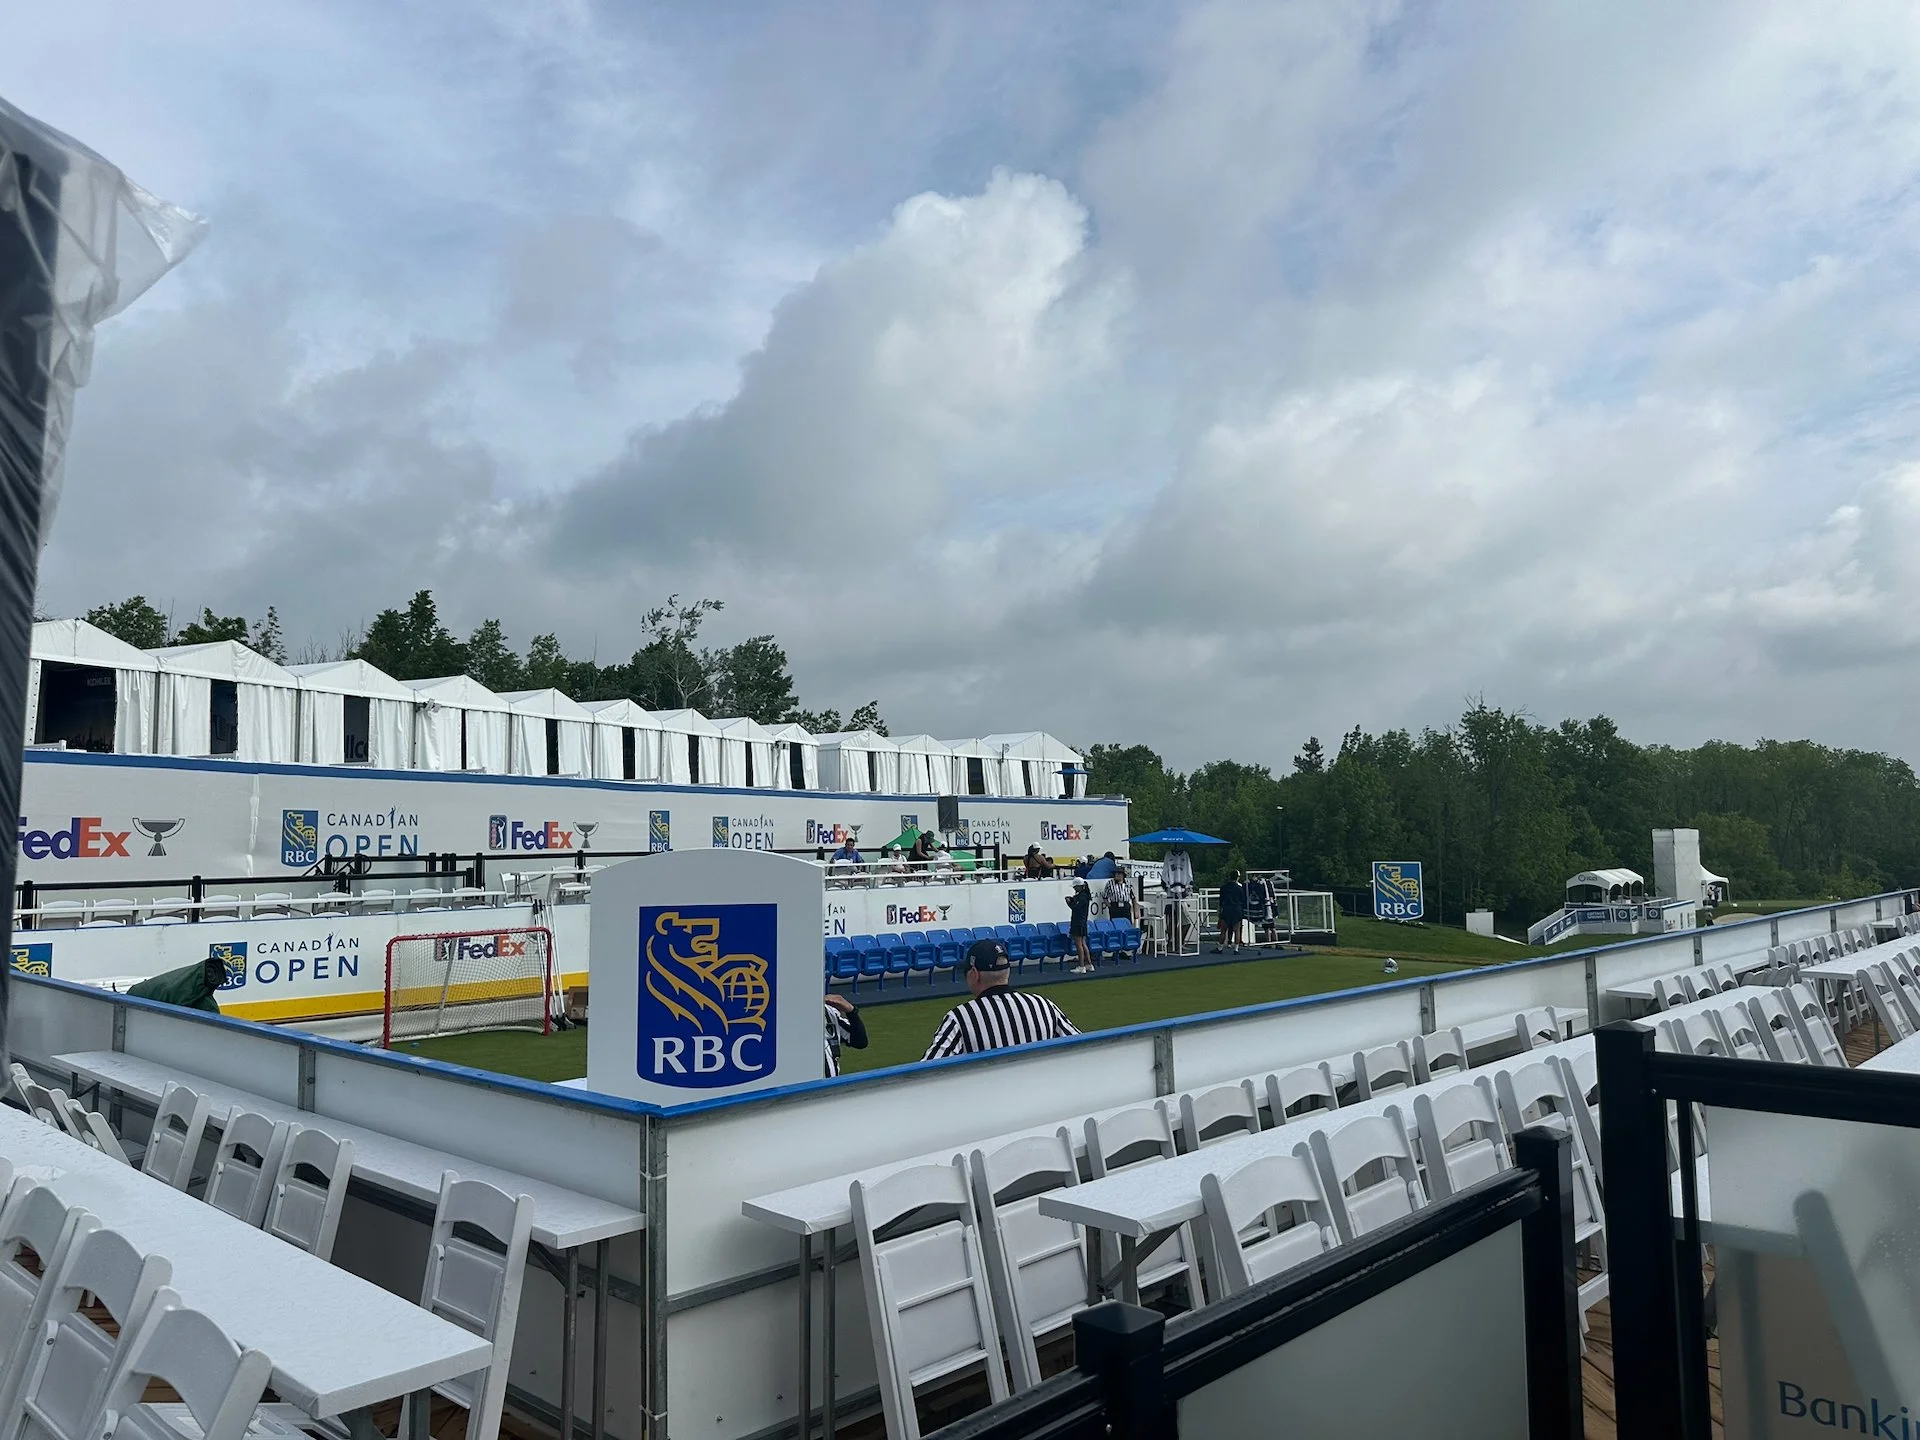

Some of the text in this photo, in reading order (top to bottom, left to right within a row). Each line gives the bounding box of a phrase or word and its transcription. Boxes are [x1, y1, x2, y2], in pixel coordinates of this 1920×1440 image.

[327, 809, 418, 828] CANADIAN
[511, 821, 574, 850] FedEx
[731, 832, 774, 849] OPEN
[817, 824, 848, 844] FedEx
[972, 831, 1010, 844] OPEN
[1051, 824, 1081, 840] FedEx
[651, 842, 669, 852] RBC
[285, 850, 315, 863] RBC
[899, 906, 937, 923] FedEx
[1009, 913, 1024, 922] RBC
[1380, 903, 1419, 915] RBC
[257, 934, 359, 954] CANADIAN
[458, 935, 525, 960] FedEx
[255, 955, 359, 983] OPEN
[652, 1034, 763, 1074] RBC
[1778, 1381, 1920, 1440] Banki
